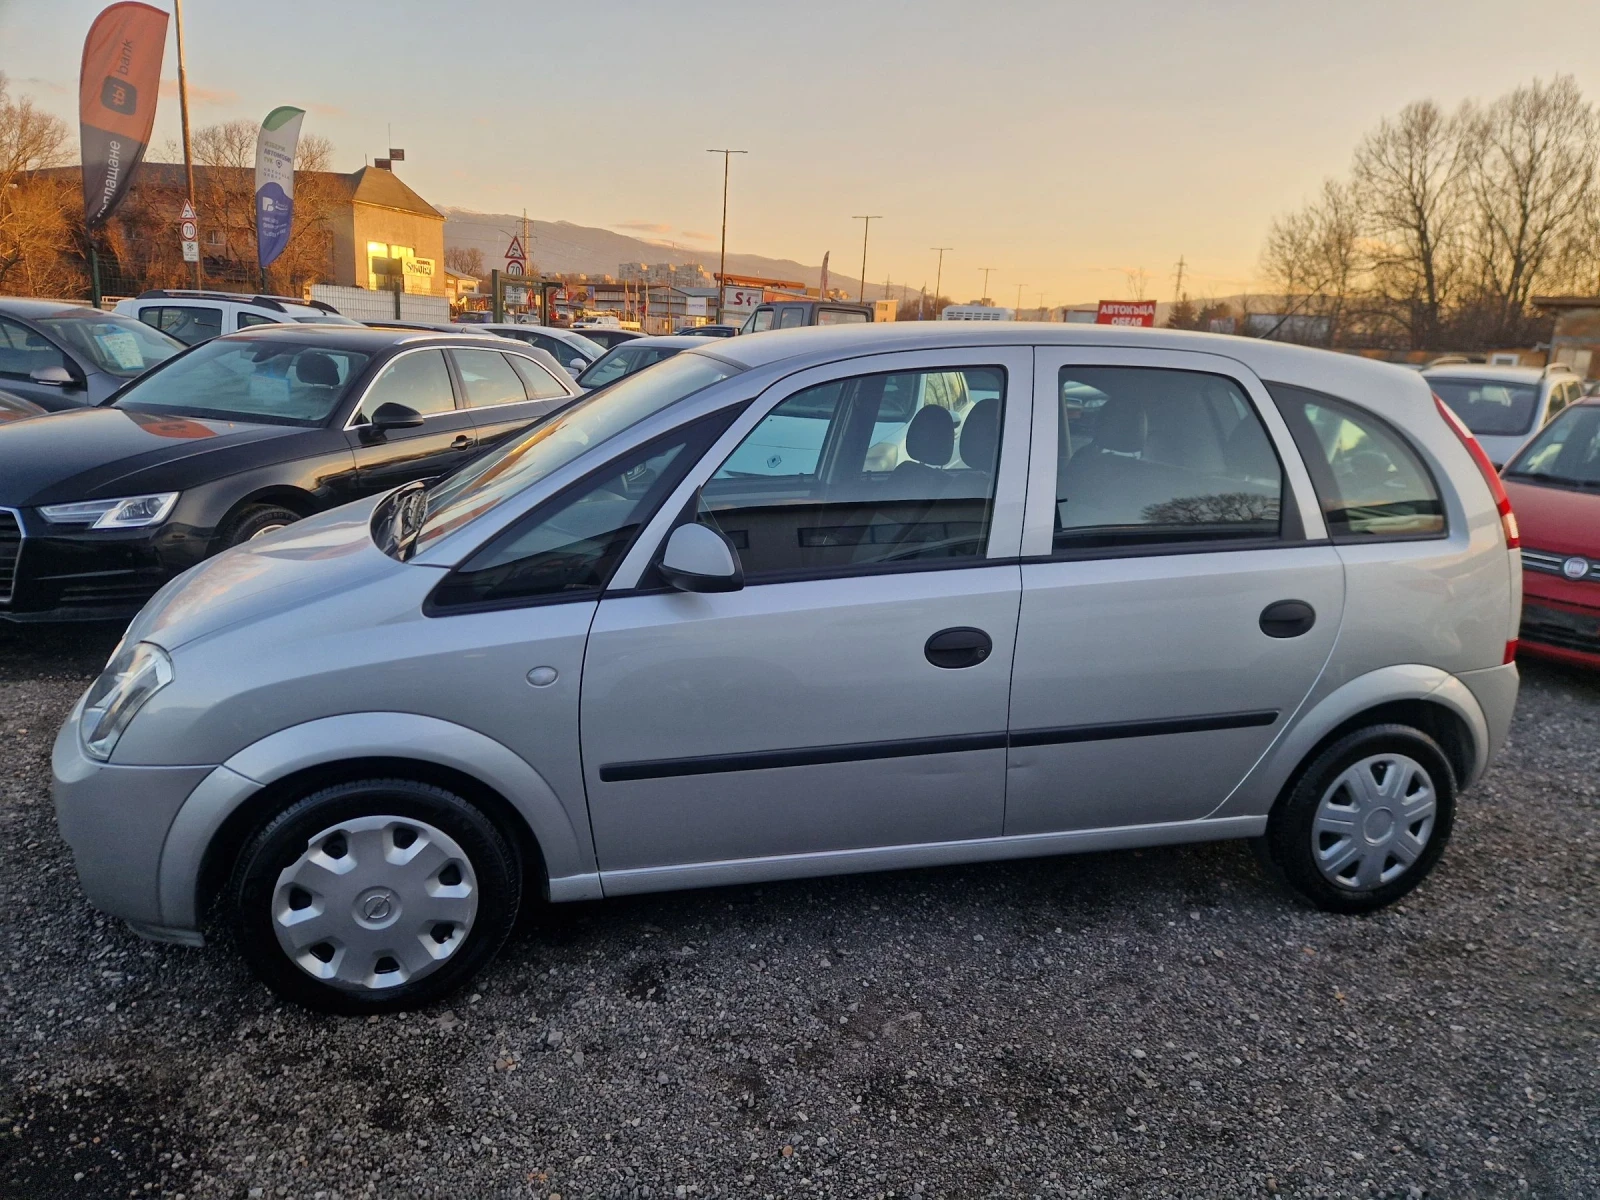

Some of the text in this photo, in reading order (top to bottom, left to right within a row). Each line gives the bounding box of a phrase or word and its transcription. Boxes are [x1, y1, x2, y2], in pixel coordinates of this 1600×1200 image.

[112, 39, 133, 106] tbi bank
[97, 140, 121, 218] плащане
[184, 225, 194, 236] 70
[510, 265, 521, 276] 70
[1100, 304, 1154, 316] АВТОКЪЩА
[1111, 317, 1143, 326] ОБЕЛЯ
